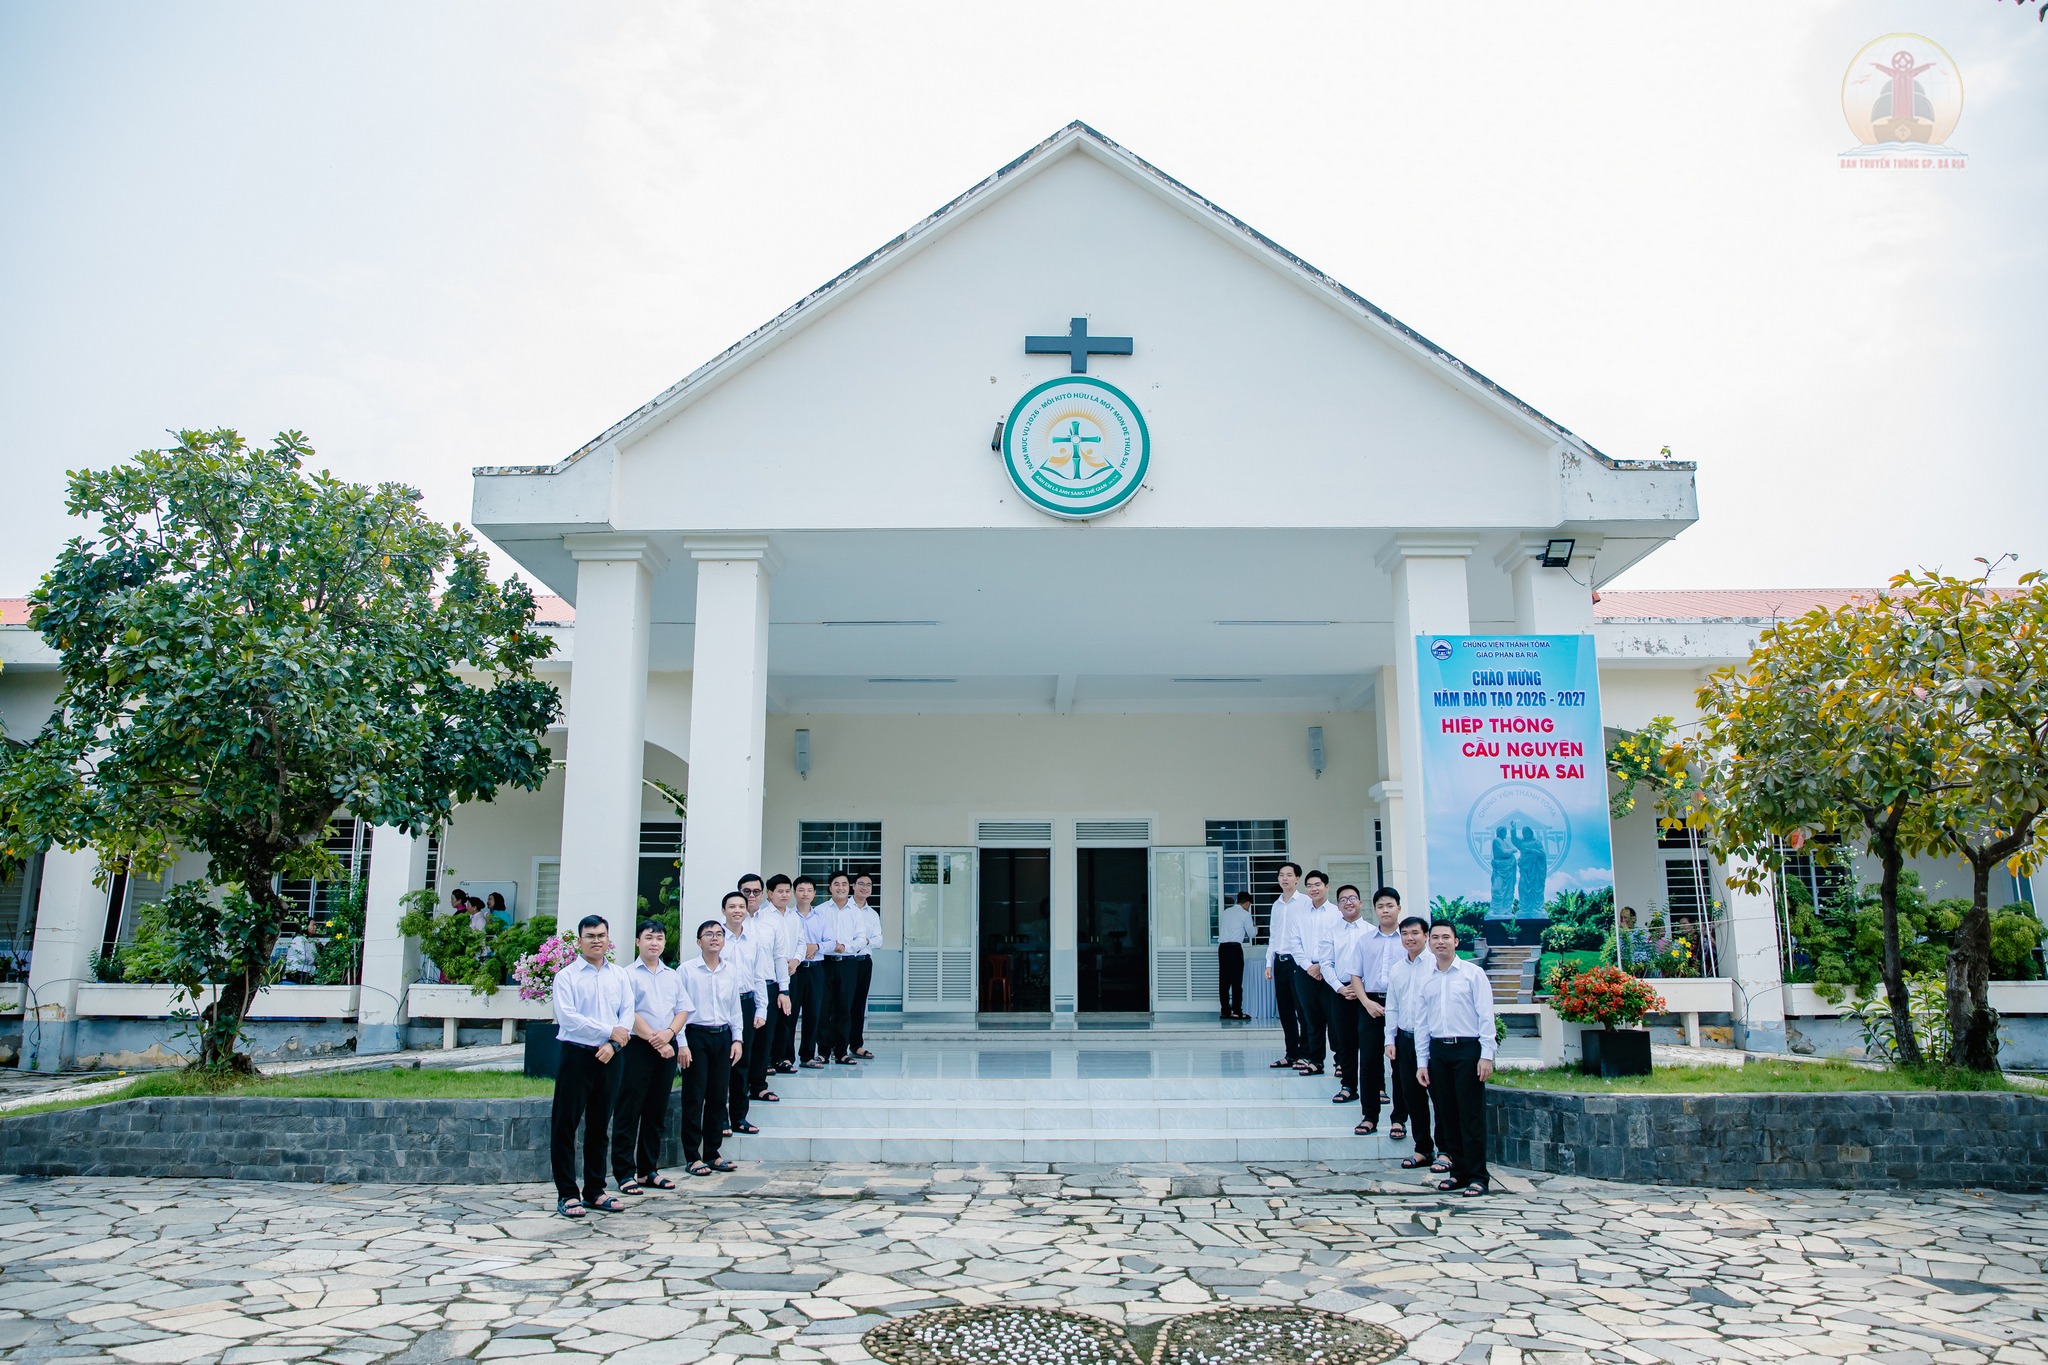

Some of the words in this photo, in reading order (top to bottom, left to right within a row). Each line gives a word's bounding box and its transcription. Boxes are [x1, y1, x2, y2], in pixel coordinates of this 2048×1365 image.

[1026, 410, 1040, 426] 2026
[1120, 456, 1128, 469] SAI
[1462, 640, 1488, 649] CHỦNG
[1488, 640, 1505, 649] VIỆN
[1530, 640, 1551, 648] TÔMA
[1475, 650, 1494, 658] GIÁO
[1515, 650, 1525, 658] BÀ
[1526, 651, 1538, 660] RỊA
[1472, 668, 1504, 686] CHÀO
[1507, 667, 1542, 686] MỪNG
[1433, 689, 1460, 707] NĂM
[1463, 689, 1487, 707] ĐÀO
[1490, 691, 1513, 710] TẠO
[1516, 691, 1547, 707] 2026
[1557, 691, 1586, 707] 2027
[1441, 715, 1483, 736] HIỆP
[1489, 715, 1554, 733] THÔNG
[1462, 736, 1500, 757] CẦU
[1507, 739, 1583, 760] NGUYỆN
[1499, 761, 1550, 779] THỪA
[1555, 763, 1584, 779] SAI
